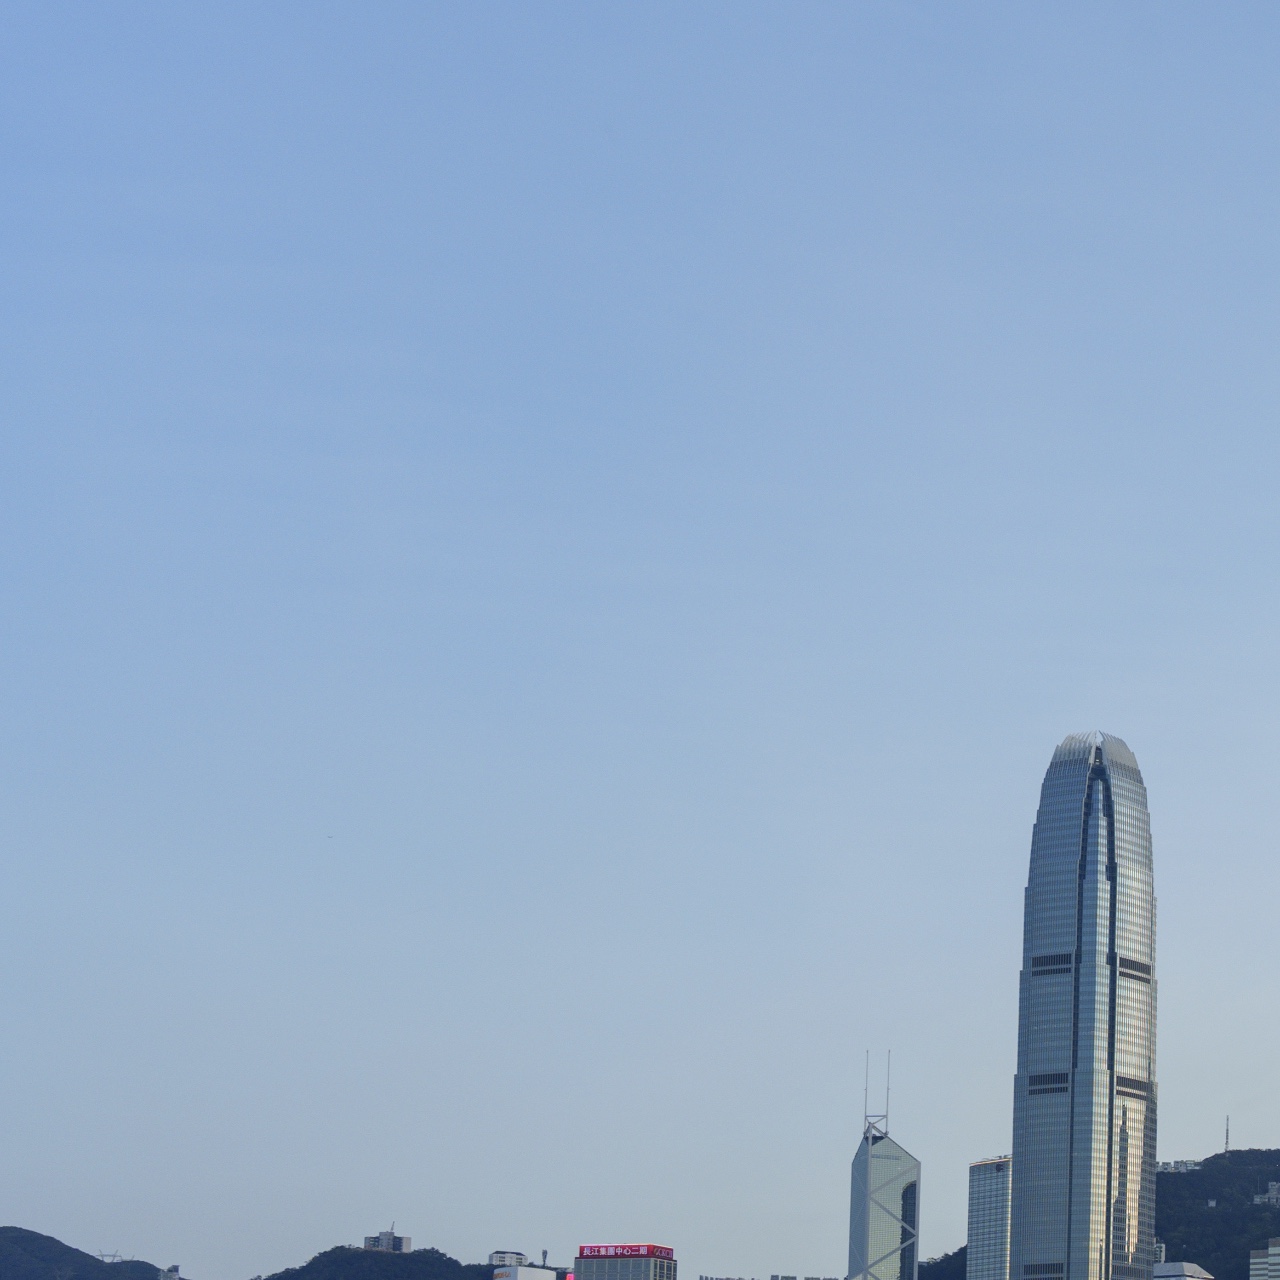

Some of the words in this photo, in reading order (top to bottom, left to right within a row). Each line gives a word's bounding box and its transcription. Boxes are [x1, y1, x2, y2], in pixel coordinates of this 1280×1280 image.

[583, 1246, 647, 1255] 長江集團中心二期
